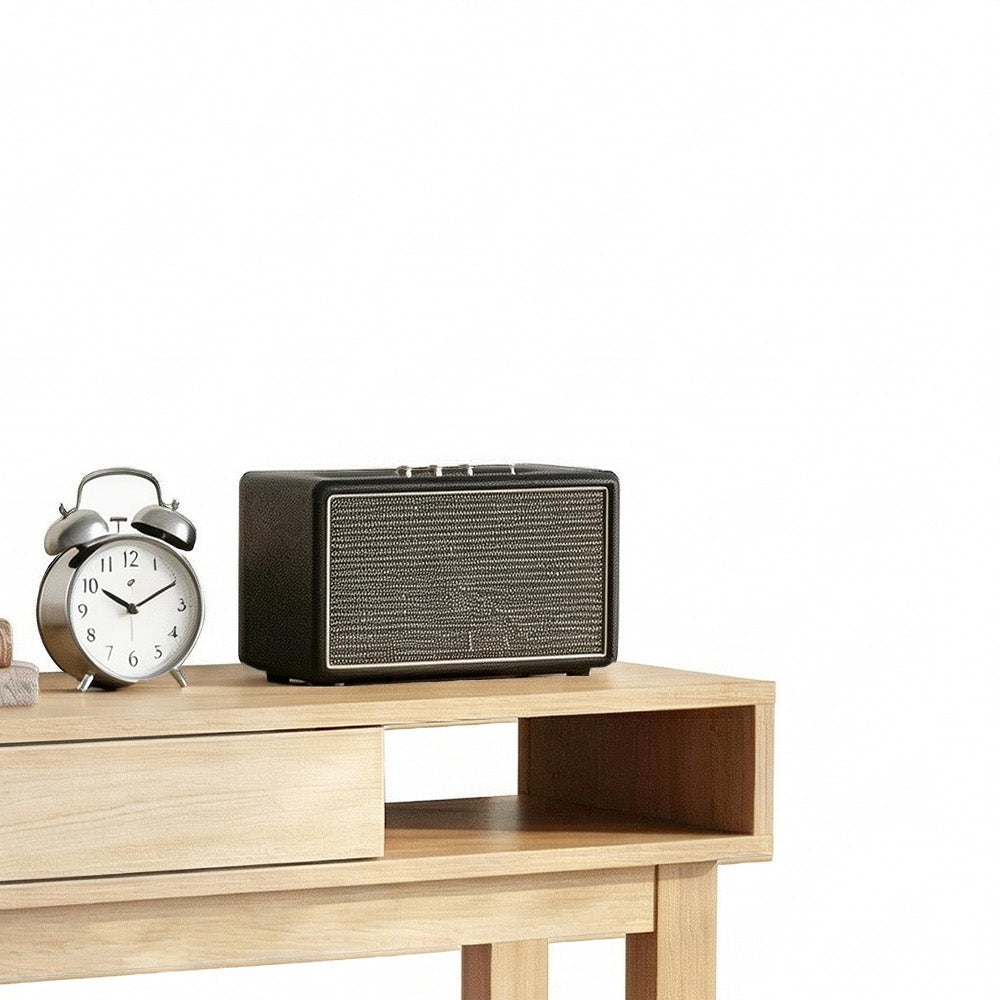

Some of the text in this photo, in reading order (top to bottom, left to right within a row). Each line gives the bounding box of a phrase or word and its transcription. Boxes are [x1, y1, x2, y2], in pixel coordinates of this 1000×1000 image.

[101, 556, 113, 572] 11
[123, 550, 139, 568] 12
[153, 558, 157, 571] 1
[83, 578, 99, 594] 10
[77, 603, 88, 619] 9
[177, 598, 187, 612] 3
[86, 628, 96, 642] 8
[167, 625, 178, 638] 4
[105, 645, 114, 661] 7
[128, 650, 139, 667] 6
[154, 645, 163, 659] 5
